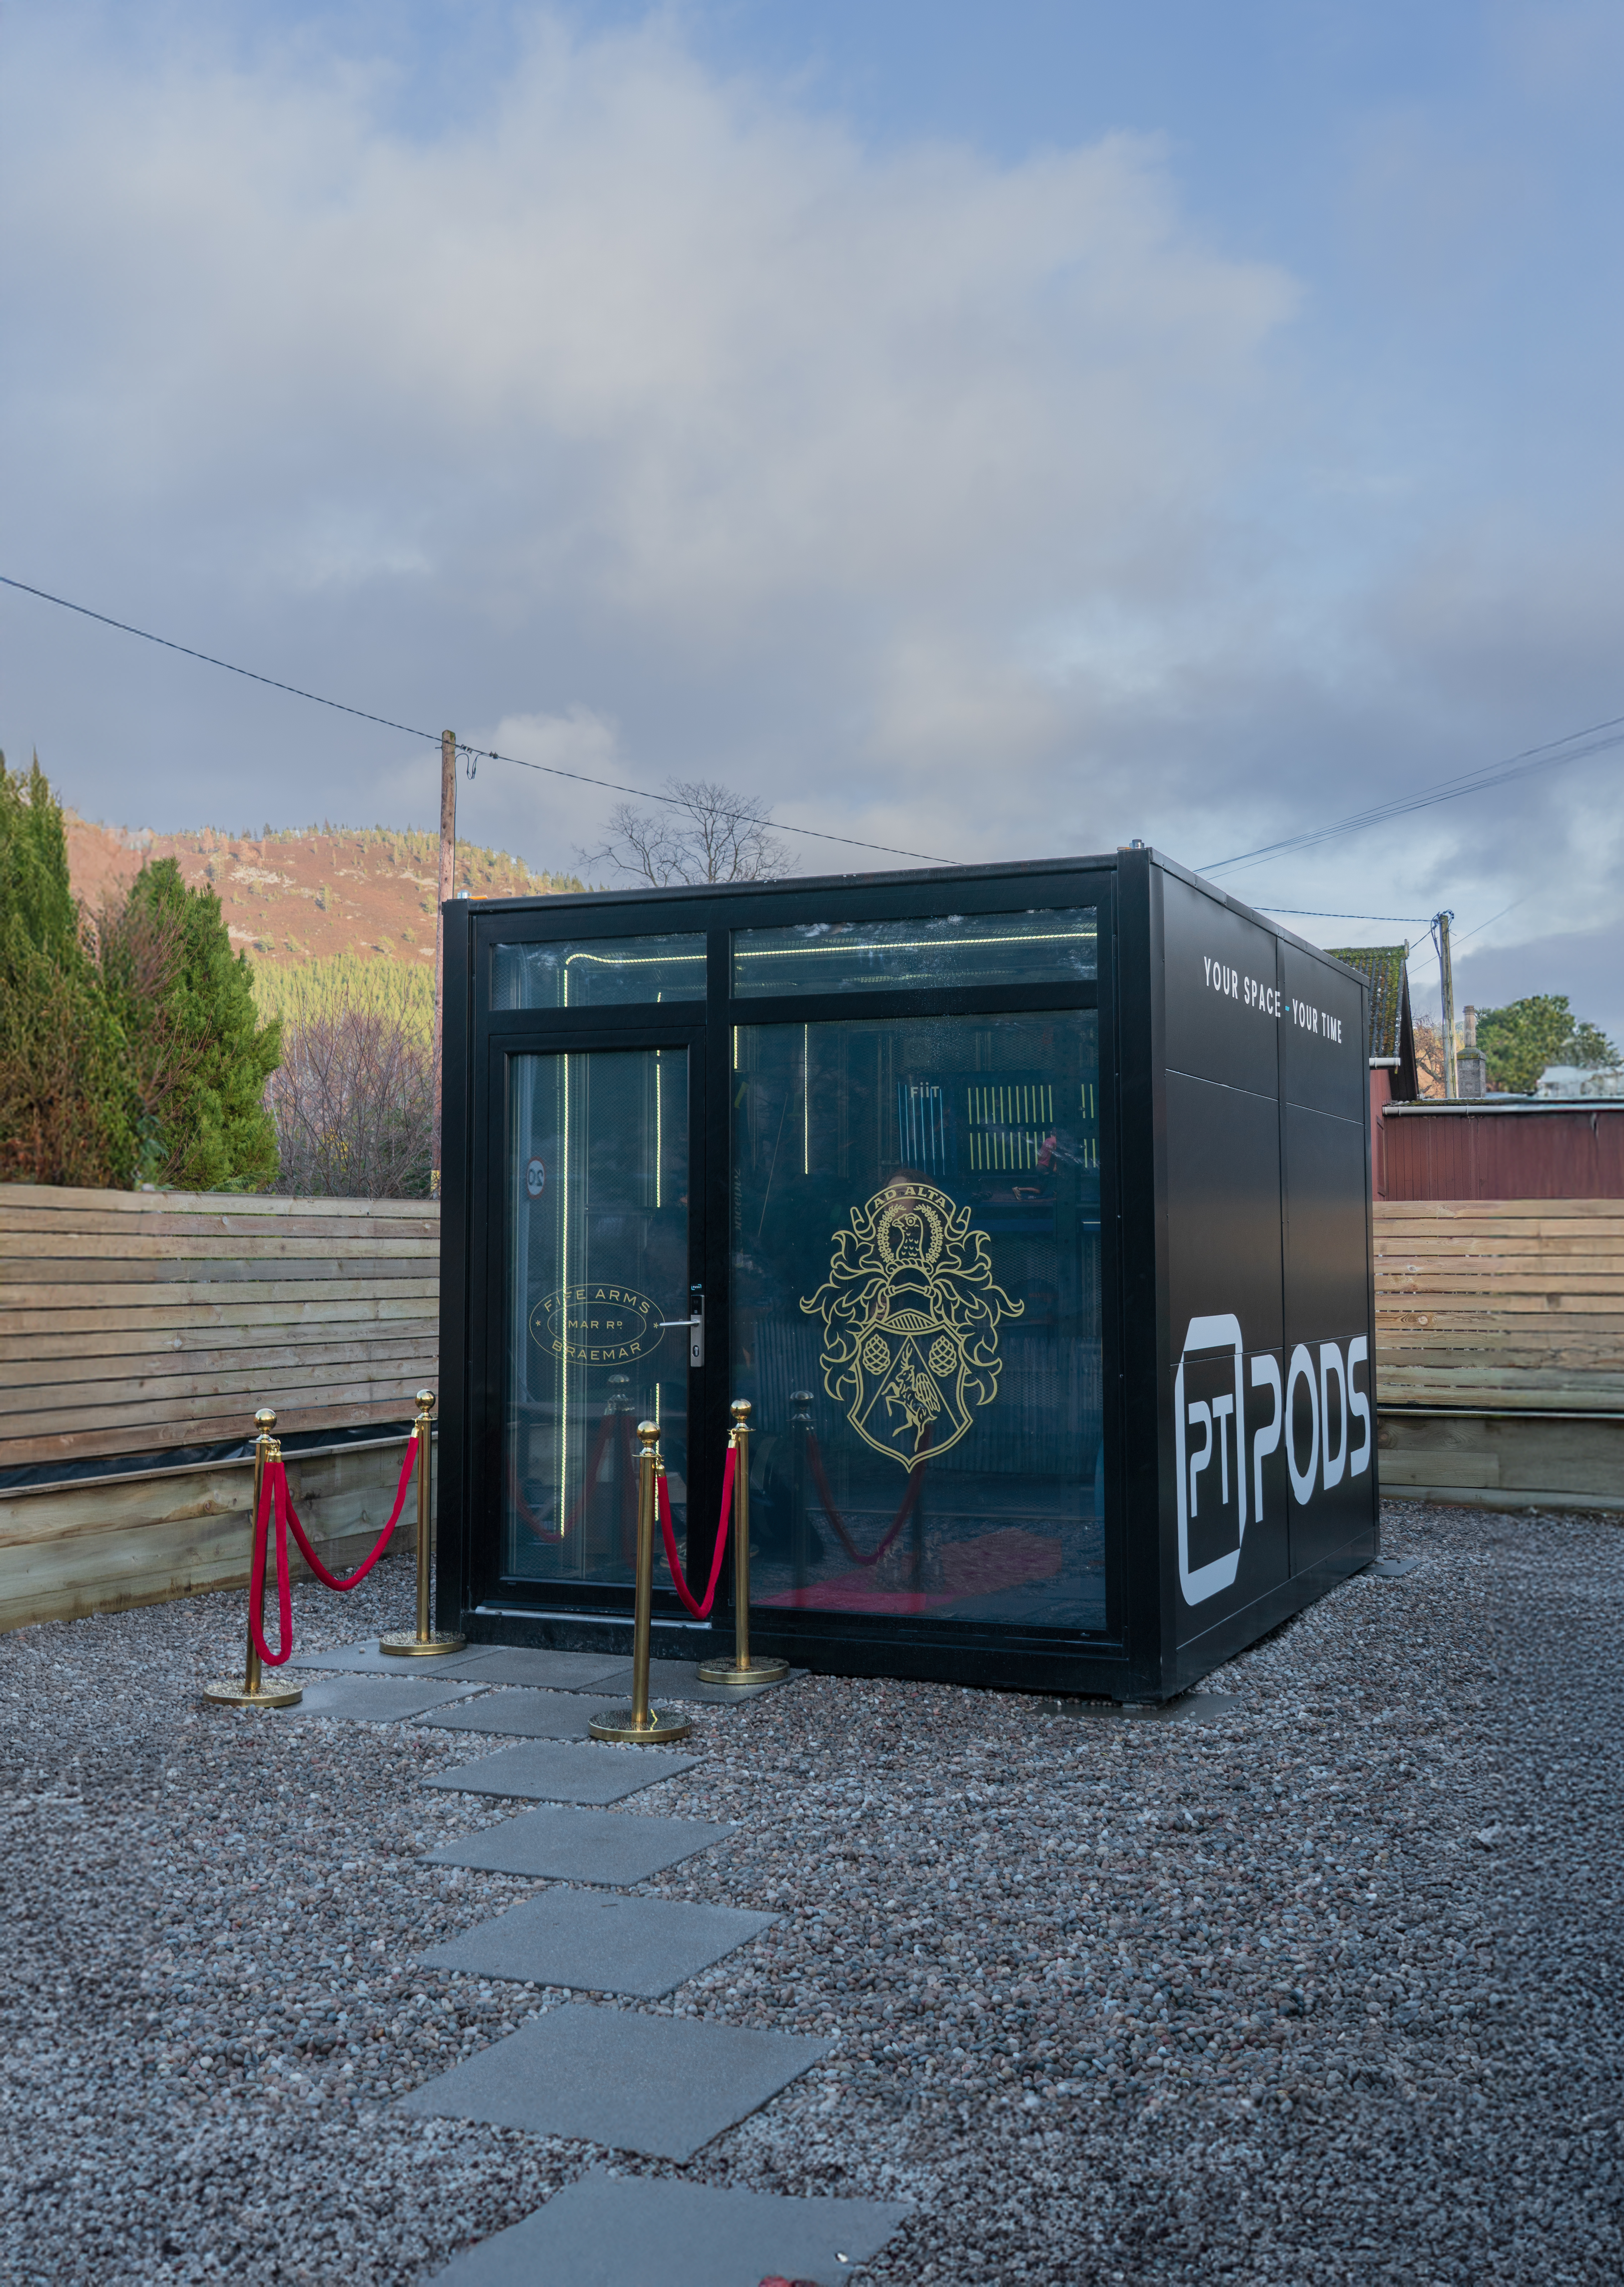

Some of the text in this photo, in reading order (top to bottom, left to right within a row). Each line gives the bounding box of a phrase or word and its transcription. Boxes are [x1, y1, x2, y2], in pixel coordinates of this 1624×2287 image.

[1204, 956, 1238, 999] YOUR
[1244, 976, 1281, 1017] SPACE
[1292, 999, 1317, 1033] YOUR
[1322, 1012, 1342, 1043] TIME
[910, 1082, 939, 1098] FiiT
[874, 1187, 946, 1209] AD ALTA
[544, 1289, 650, 1313] FIFE ARMS
[552, 1340, 641, 1360] BRAEMAR
[1189, 1336, 1371, 1523] PT PODS
